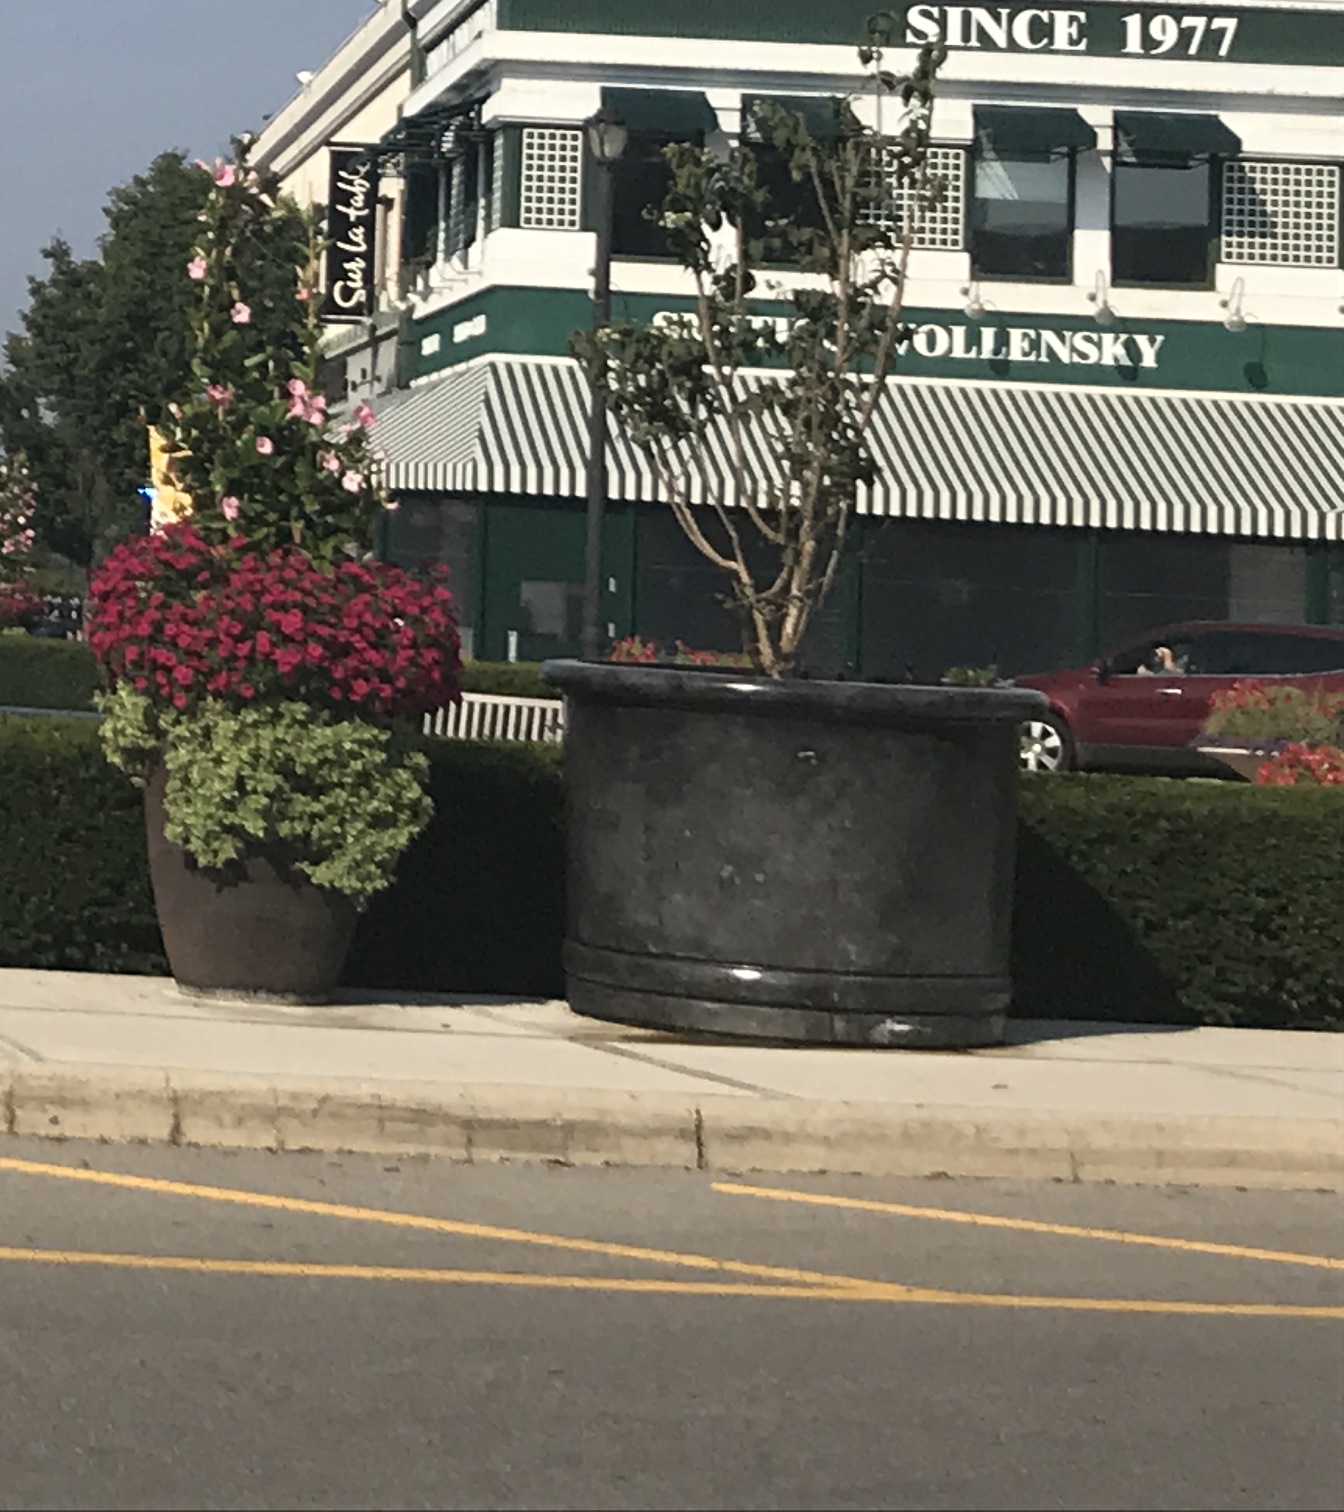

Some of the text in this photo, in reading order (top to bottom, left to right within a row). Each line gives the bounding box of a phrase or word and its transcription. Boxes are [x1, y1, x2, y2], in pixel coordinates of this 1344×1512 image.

[905, 3, 1239, 57] SINCE 1977
[335, 225, 368, 253] la
[333, 256, 367, 308] Sur
